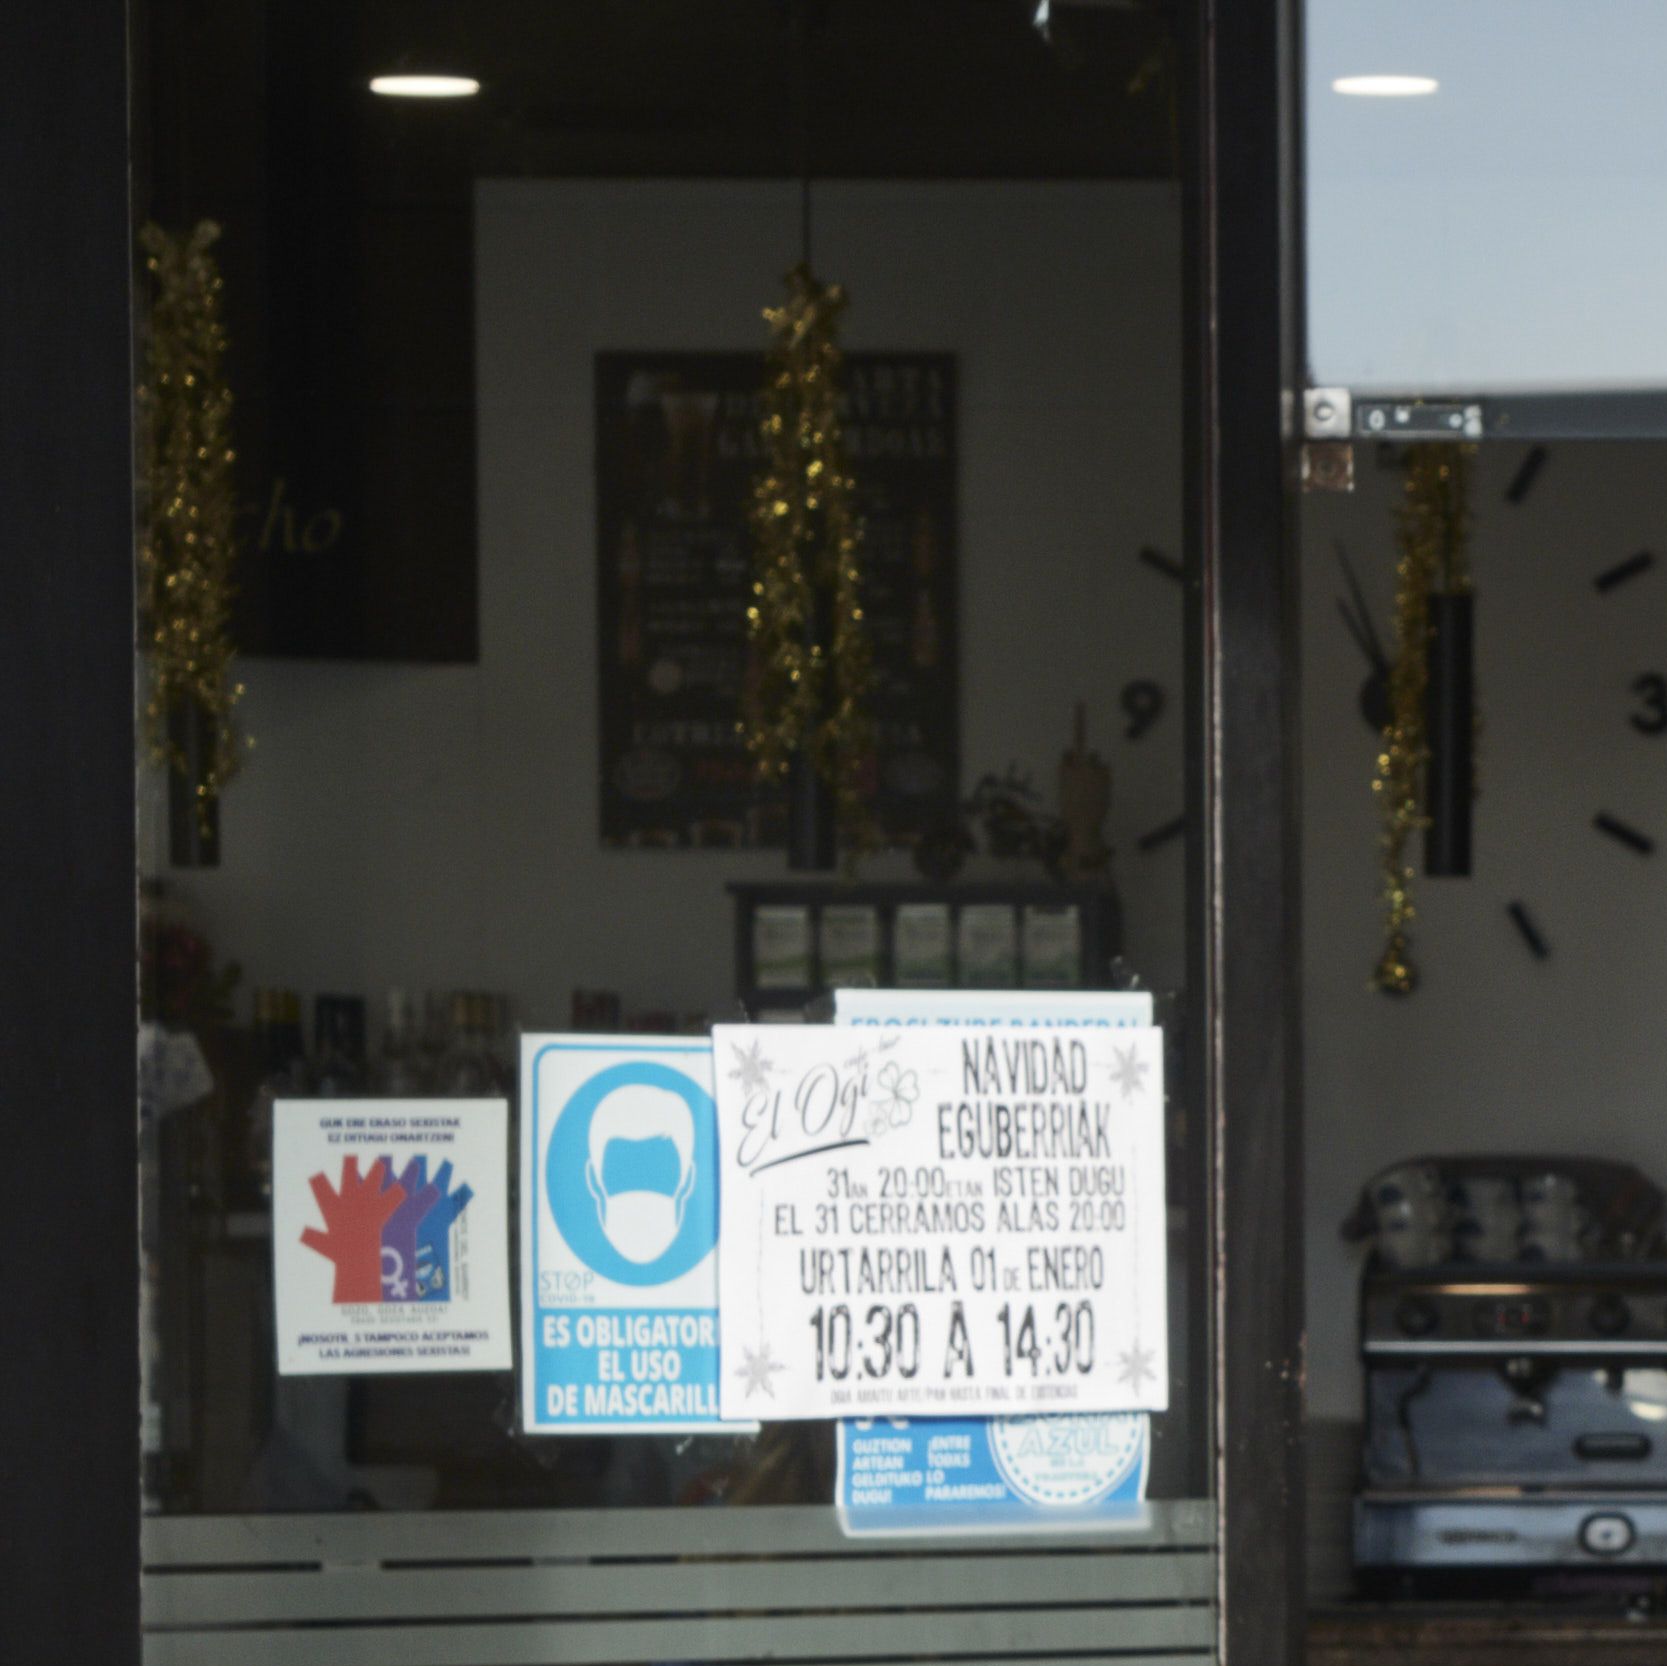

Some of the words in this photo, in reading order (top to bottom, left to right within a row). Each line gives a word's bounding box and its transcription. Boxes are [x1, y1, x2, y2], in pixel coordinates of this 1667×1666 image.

[961, 1036, 1087, 1095] NAVIDAD
[937, 1101, 1112, 1160] EGUBERRIAK
[993, 1167, 1059, 1197] ISTEN
[1069, 1165, 1126, 1197] DUGU
[775, 1204, 803, 1235] EL
[814, 1203, 842, 1234] 31
[850, 1201, 985, 1234] CERRAMOS
[1069, 1199, 1127, 1232] 20:00
[800, 1246, 958, 1294] URTARRILA
[970, 1245, 998, 1292] 01
[1003, 1267, 1023, 1292] DE
[1028, 1245, 1105, 1291] ENERO
[543, 1315, 571, 1348] ES
[809, 1302, 920, 1382] 10:30
[943, 1300, 975, 1378] A
[996, 1300, 1096, 1378] 14:30
[598, 1350, 625, 1382] EL
[631, 1350, 682, 1382] USO
[547, 1384, 579, 1416] DE
